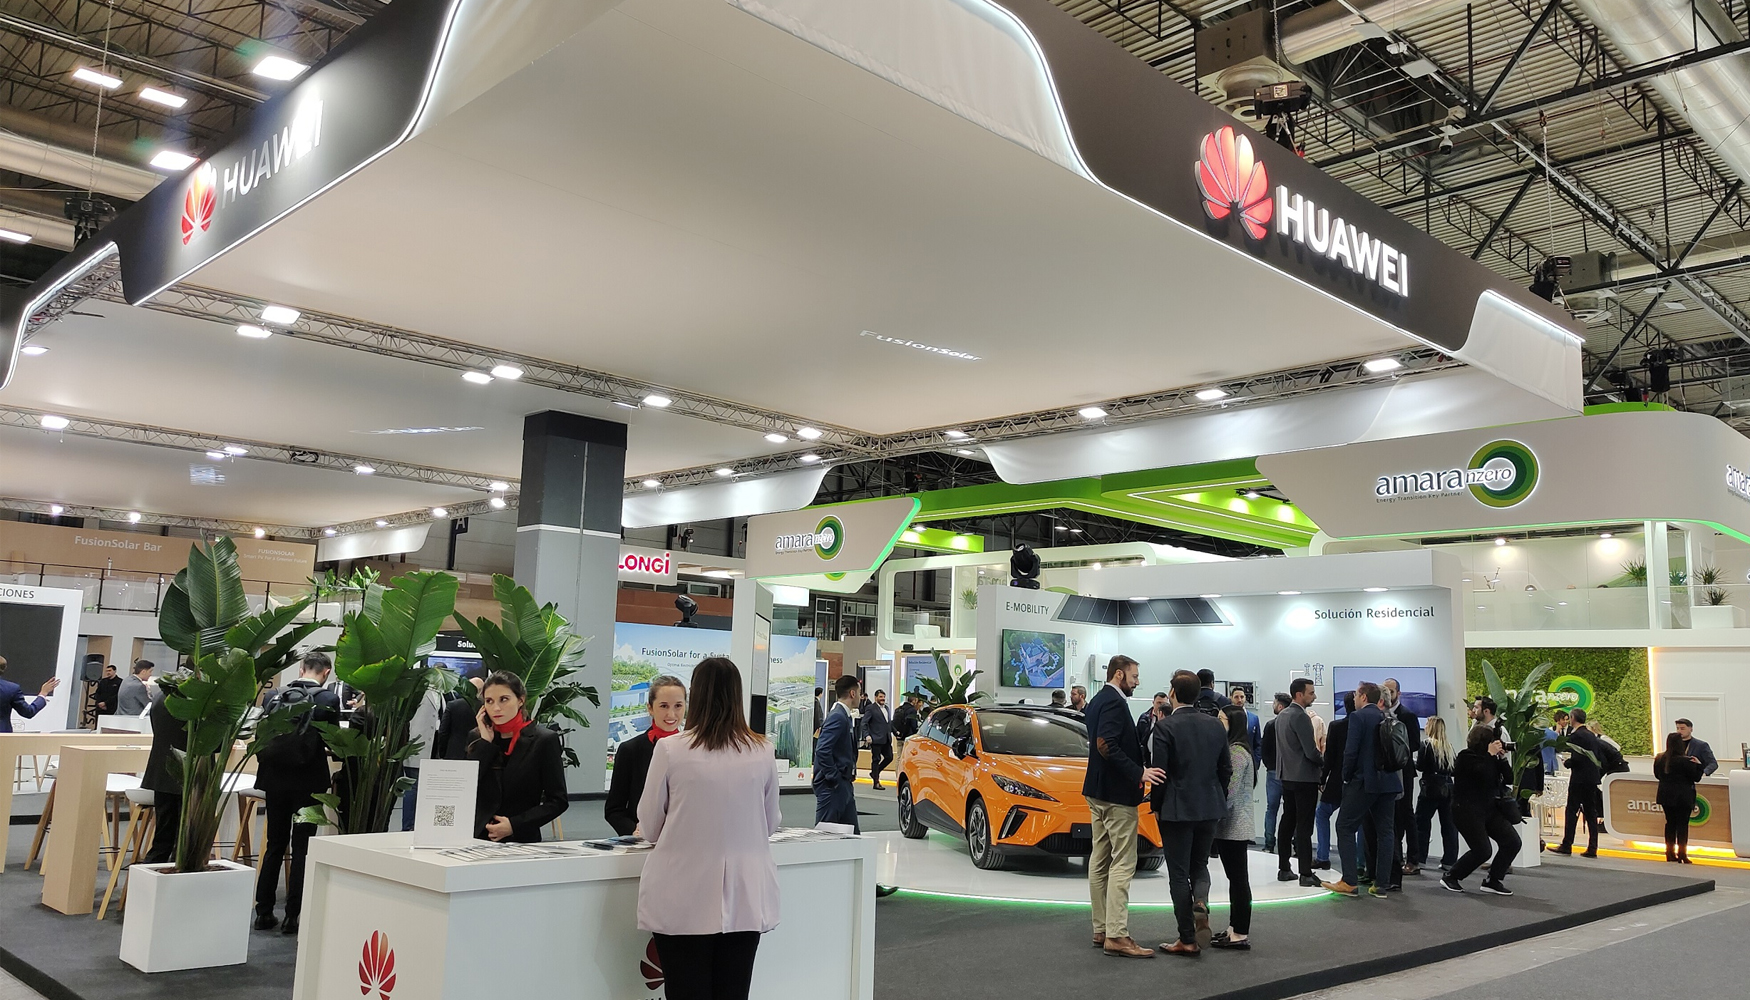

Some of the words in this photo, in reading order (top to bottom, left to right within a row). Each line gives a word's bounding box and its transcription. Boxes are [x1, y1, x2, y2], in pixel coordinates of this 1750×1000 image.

[1275, 184, 1409, 298] HUAWEI
[860, 329, 982, 361] FusionSolar
[1376, 468, 1464, 496] amara
[1466, 468, 1512, 484] nzero
[1398, 494, 1427, 502] Transition
[74, 536, 140, 551] FusionSolar
[143, 542, 162, 552] Bar
[775, 532, 814, 550] amara
[1005, 601, 1049, 615] E-MOBILITY
[1314, 608, 1362, 620] Solución
[1366, 606, 1434, 619] Residencial
[641, 647, 687, 659] FusionSolar
[689, 650, 700, 659] for
